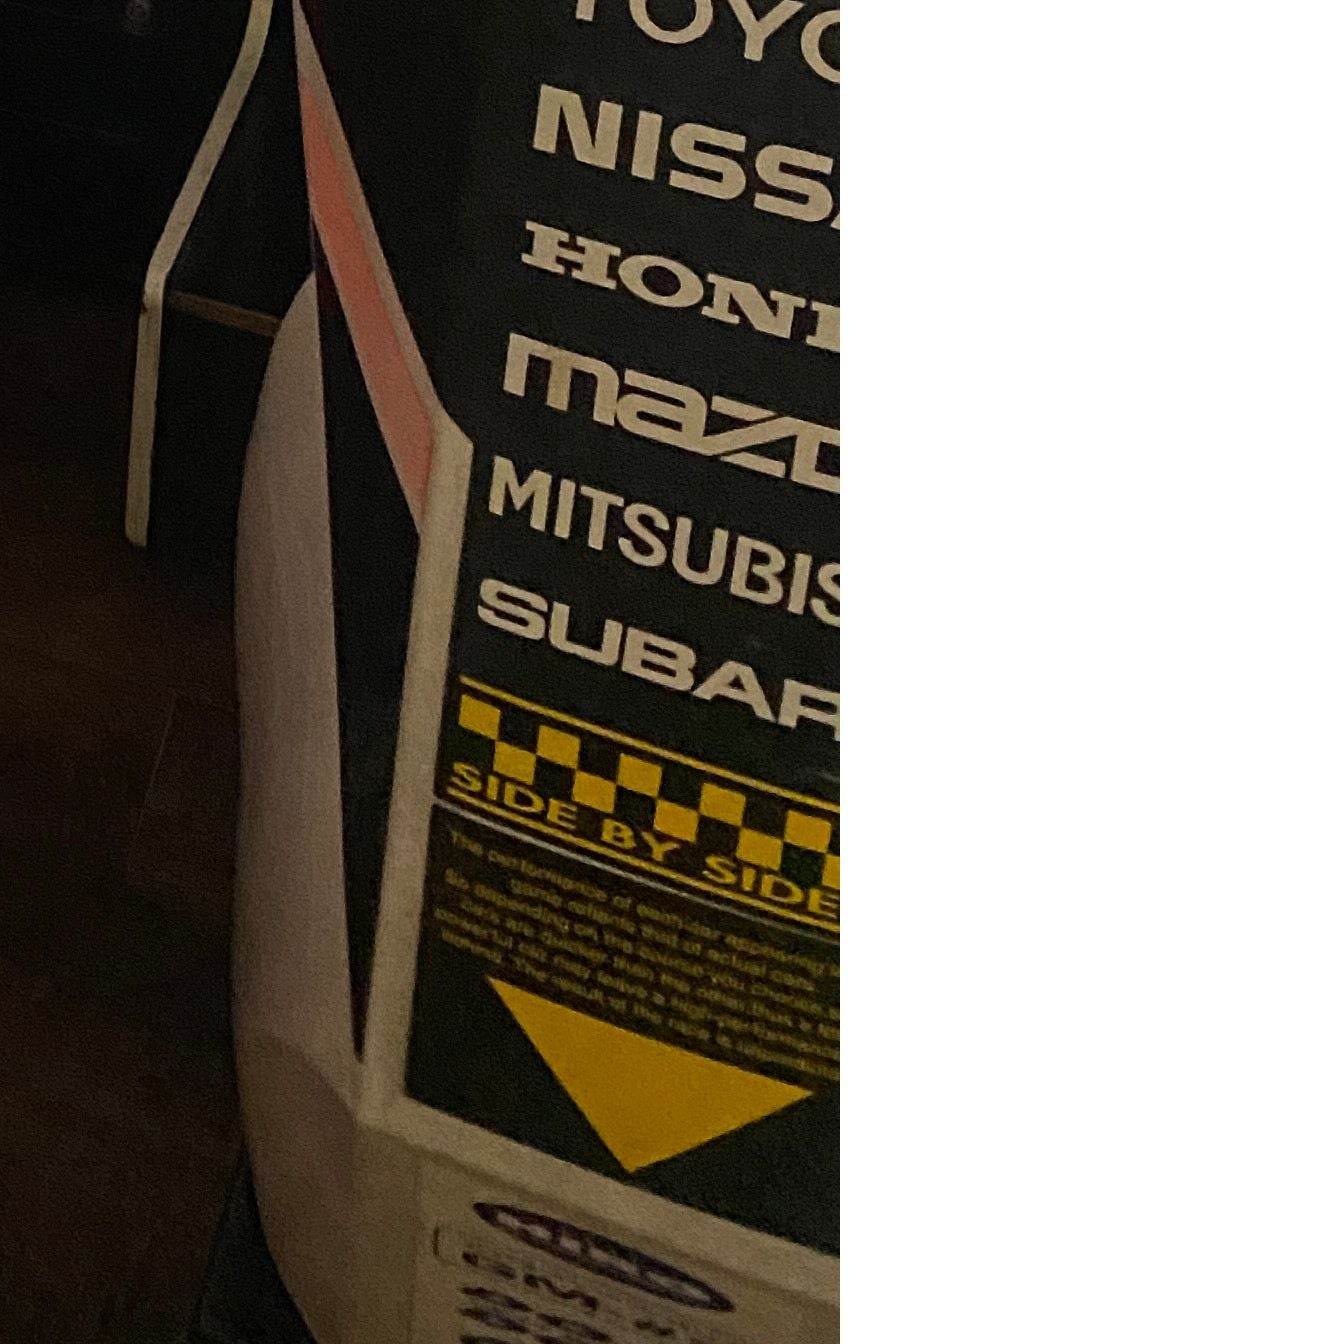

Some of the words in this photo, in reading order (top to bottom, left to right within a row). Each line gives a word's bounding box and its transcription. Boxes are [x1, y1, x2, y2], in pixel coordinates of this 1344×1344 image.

[532, 84, 840, 230] NISS
[452, 761, 578, 831] SIDE
[600, 819, 680, 863] BY
[702, 855, 840, 918] SIDE
